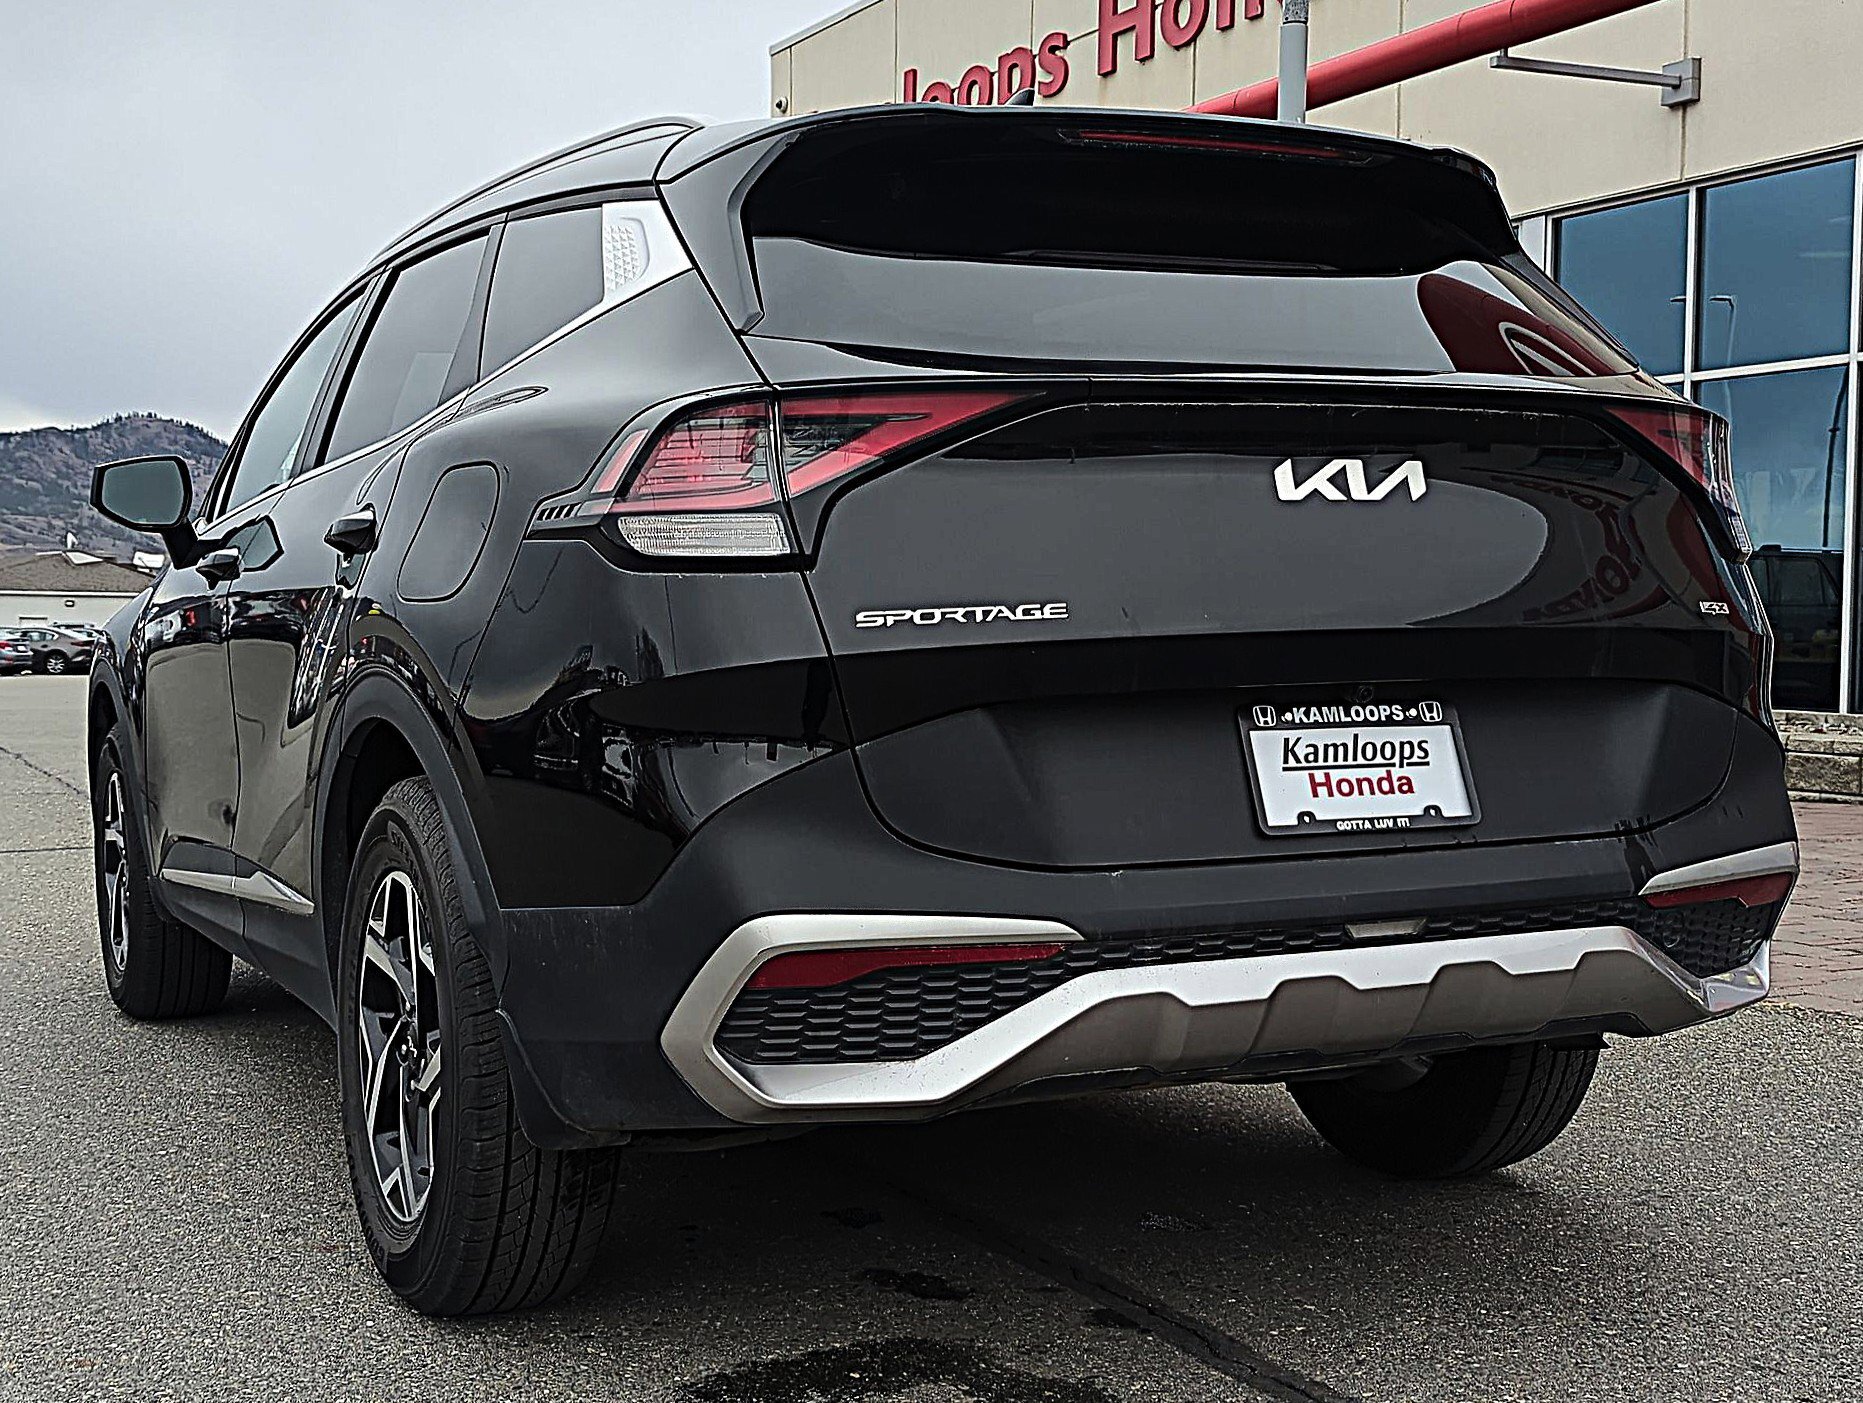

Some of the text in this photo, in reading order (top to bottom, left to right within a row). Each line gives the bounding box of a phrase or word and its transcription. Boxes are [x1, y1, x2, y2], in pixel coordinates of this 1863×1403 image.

[1273, 458, 1427, 501] KIA
[855, 602, 1069, 627] SPORTAGE
[1282, 733, 1430, 768] Kamloops
[1308, 770, 1415, 798] Honda
[1336, 819, 1372, 831] GOTTA
[1374, 818, 1393, 829] LUV
